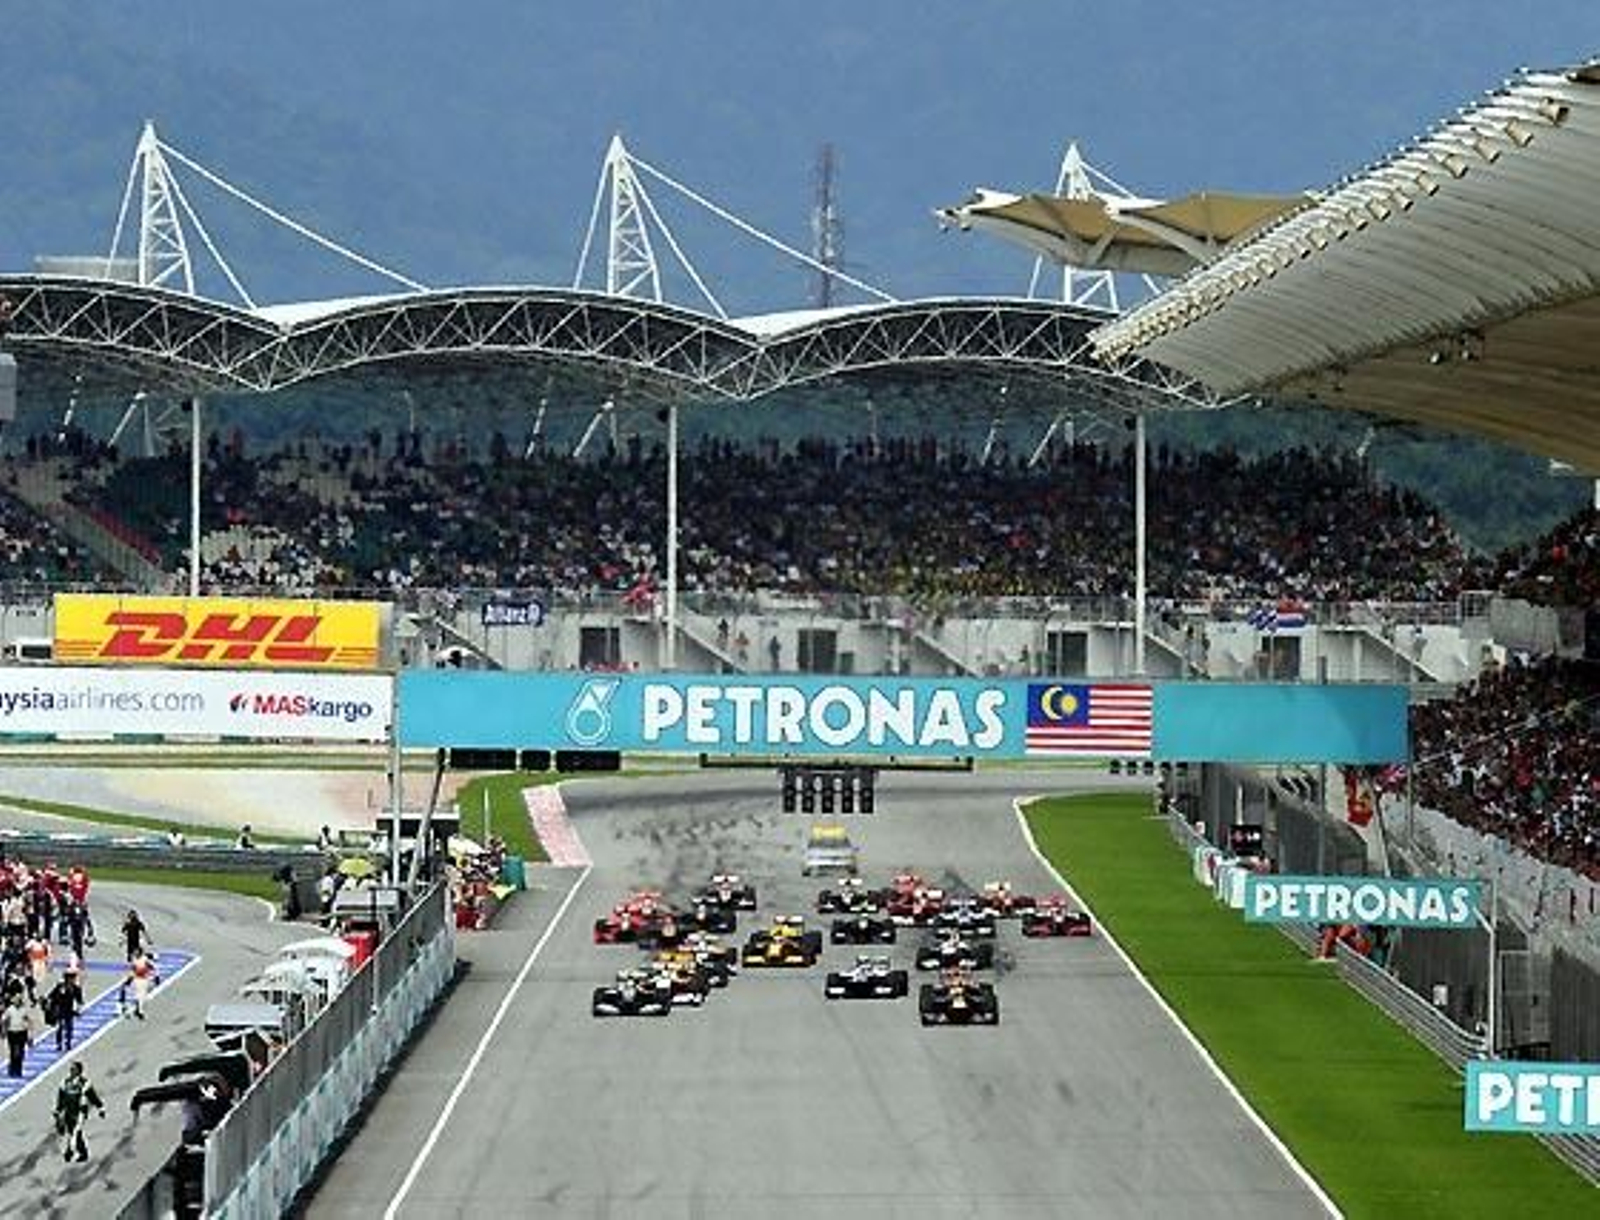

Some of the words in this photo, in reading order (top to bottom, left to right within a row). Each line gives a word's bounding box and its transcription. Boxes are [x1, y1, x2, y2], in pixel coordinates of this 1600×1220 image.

[98, 612, 336, 661] DHL
[0, 687, 205, 717] ysiaairlines.com
[253, 694, 373, 723] MASkargo
[642, 683, 1006, 750] PETRONAS
[1255, 882, 1470, 923] PETRONAS
